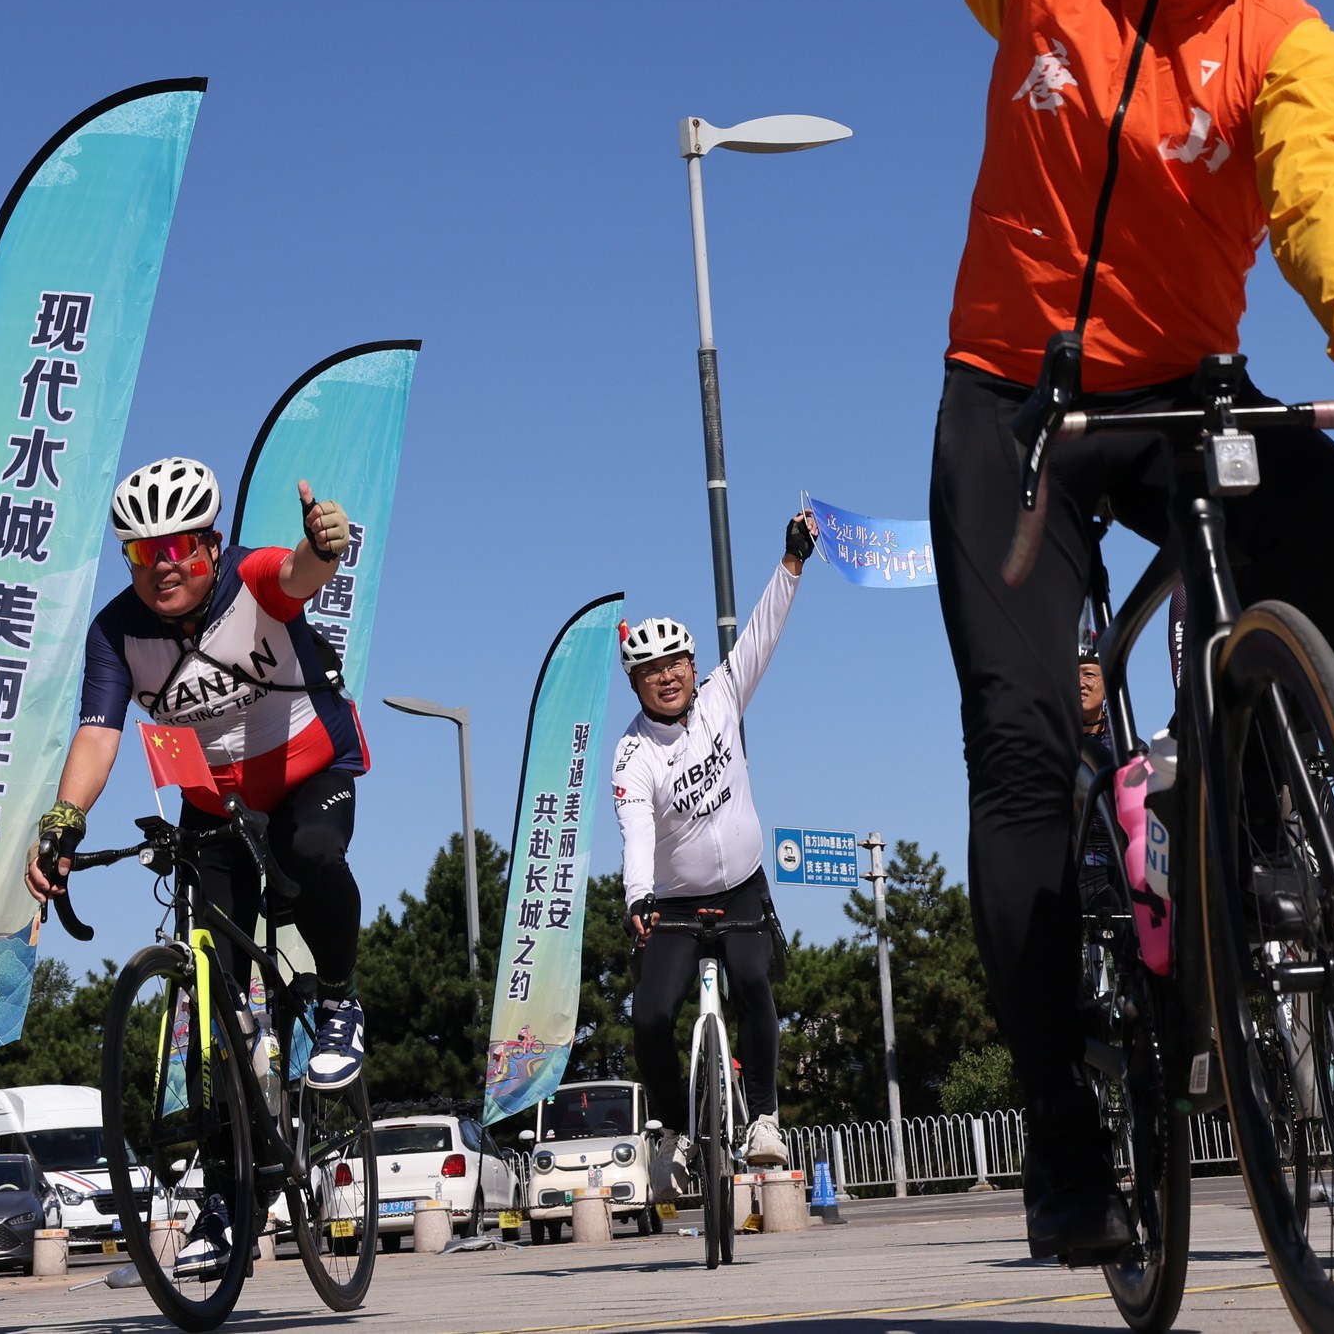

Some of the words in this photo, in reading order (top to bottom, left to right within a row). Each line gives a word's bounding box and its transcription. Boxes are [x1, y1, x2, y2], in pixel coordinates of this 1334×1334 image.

[156, 705, 225, 725] YCLING
[545, 722, 590, 931] 骑遇美丽迁安
[508, 792, 559, 1002] 共赴长城之约
[201, 1055, 212, 1111] GIANT
